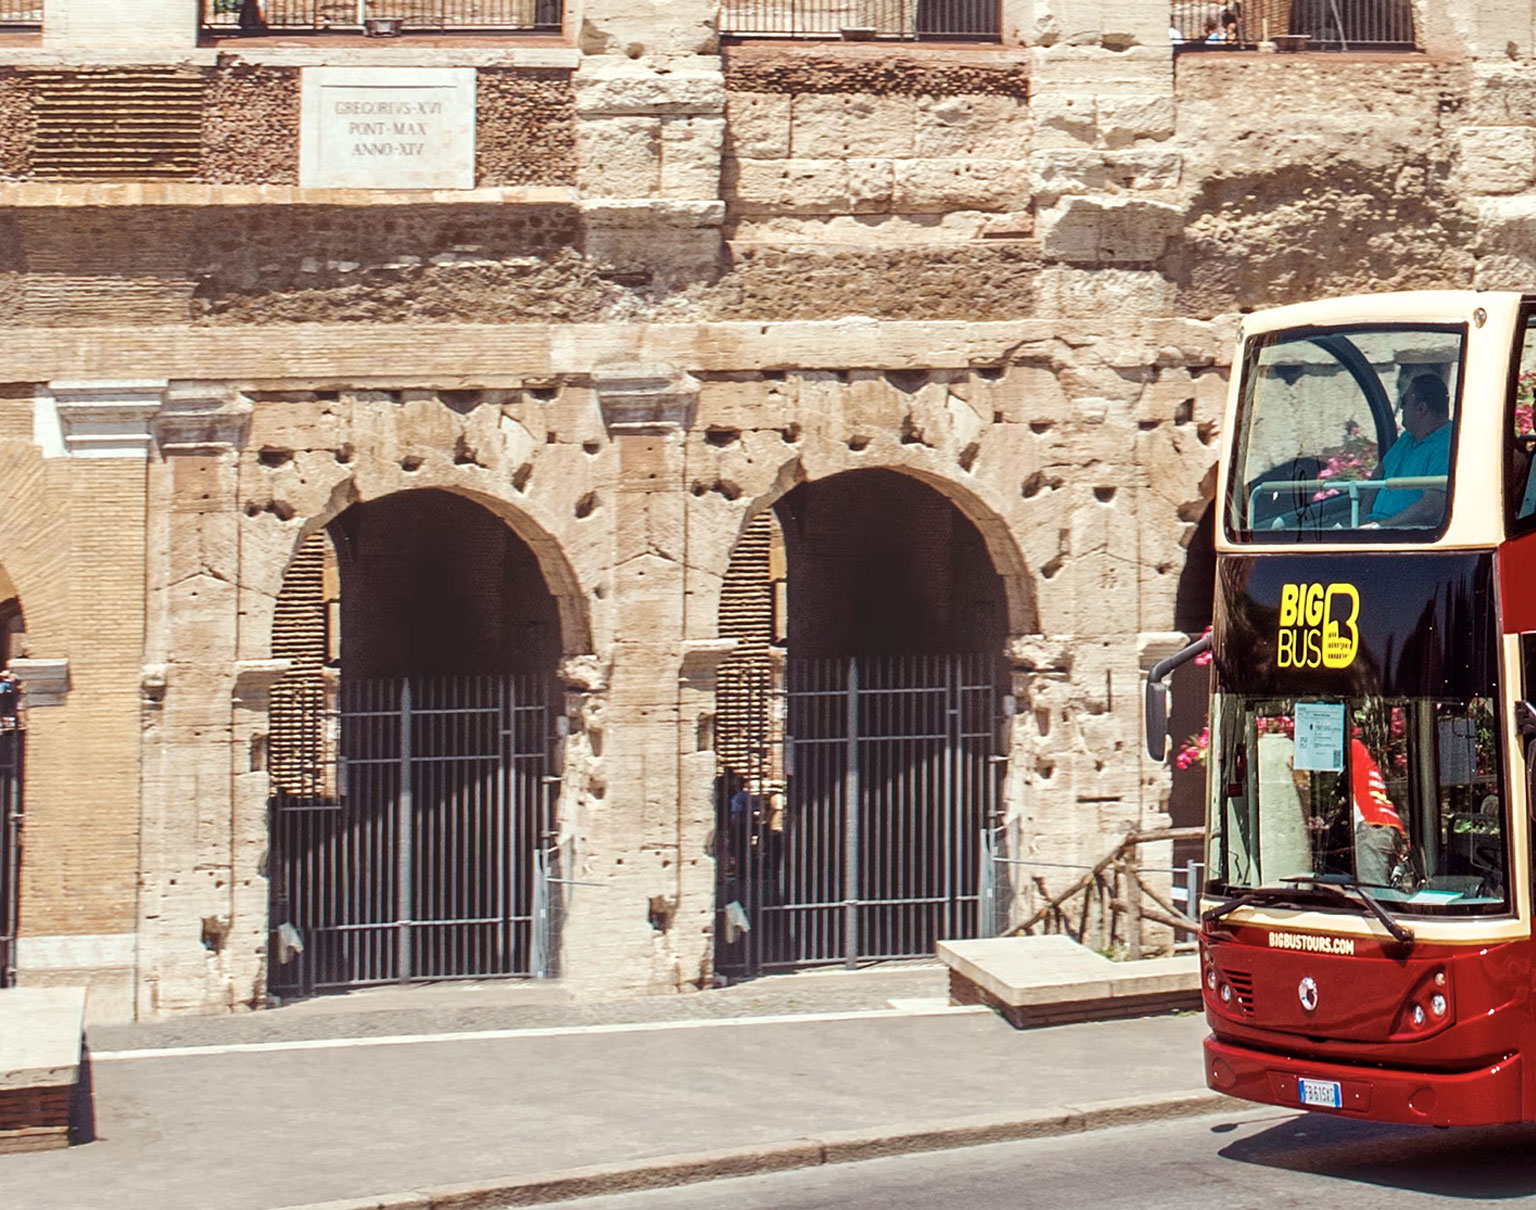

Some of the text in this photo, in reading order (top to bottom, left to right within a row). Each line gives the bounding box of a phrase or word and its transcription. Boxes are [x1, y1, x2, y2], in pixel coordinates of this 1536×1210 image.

[1279, 584, 1323, 628] BIG
[1277, 628, 1321, 668] BUS
[1268, 932, 1355, 956] BIGBUSTOURS.COM
